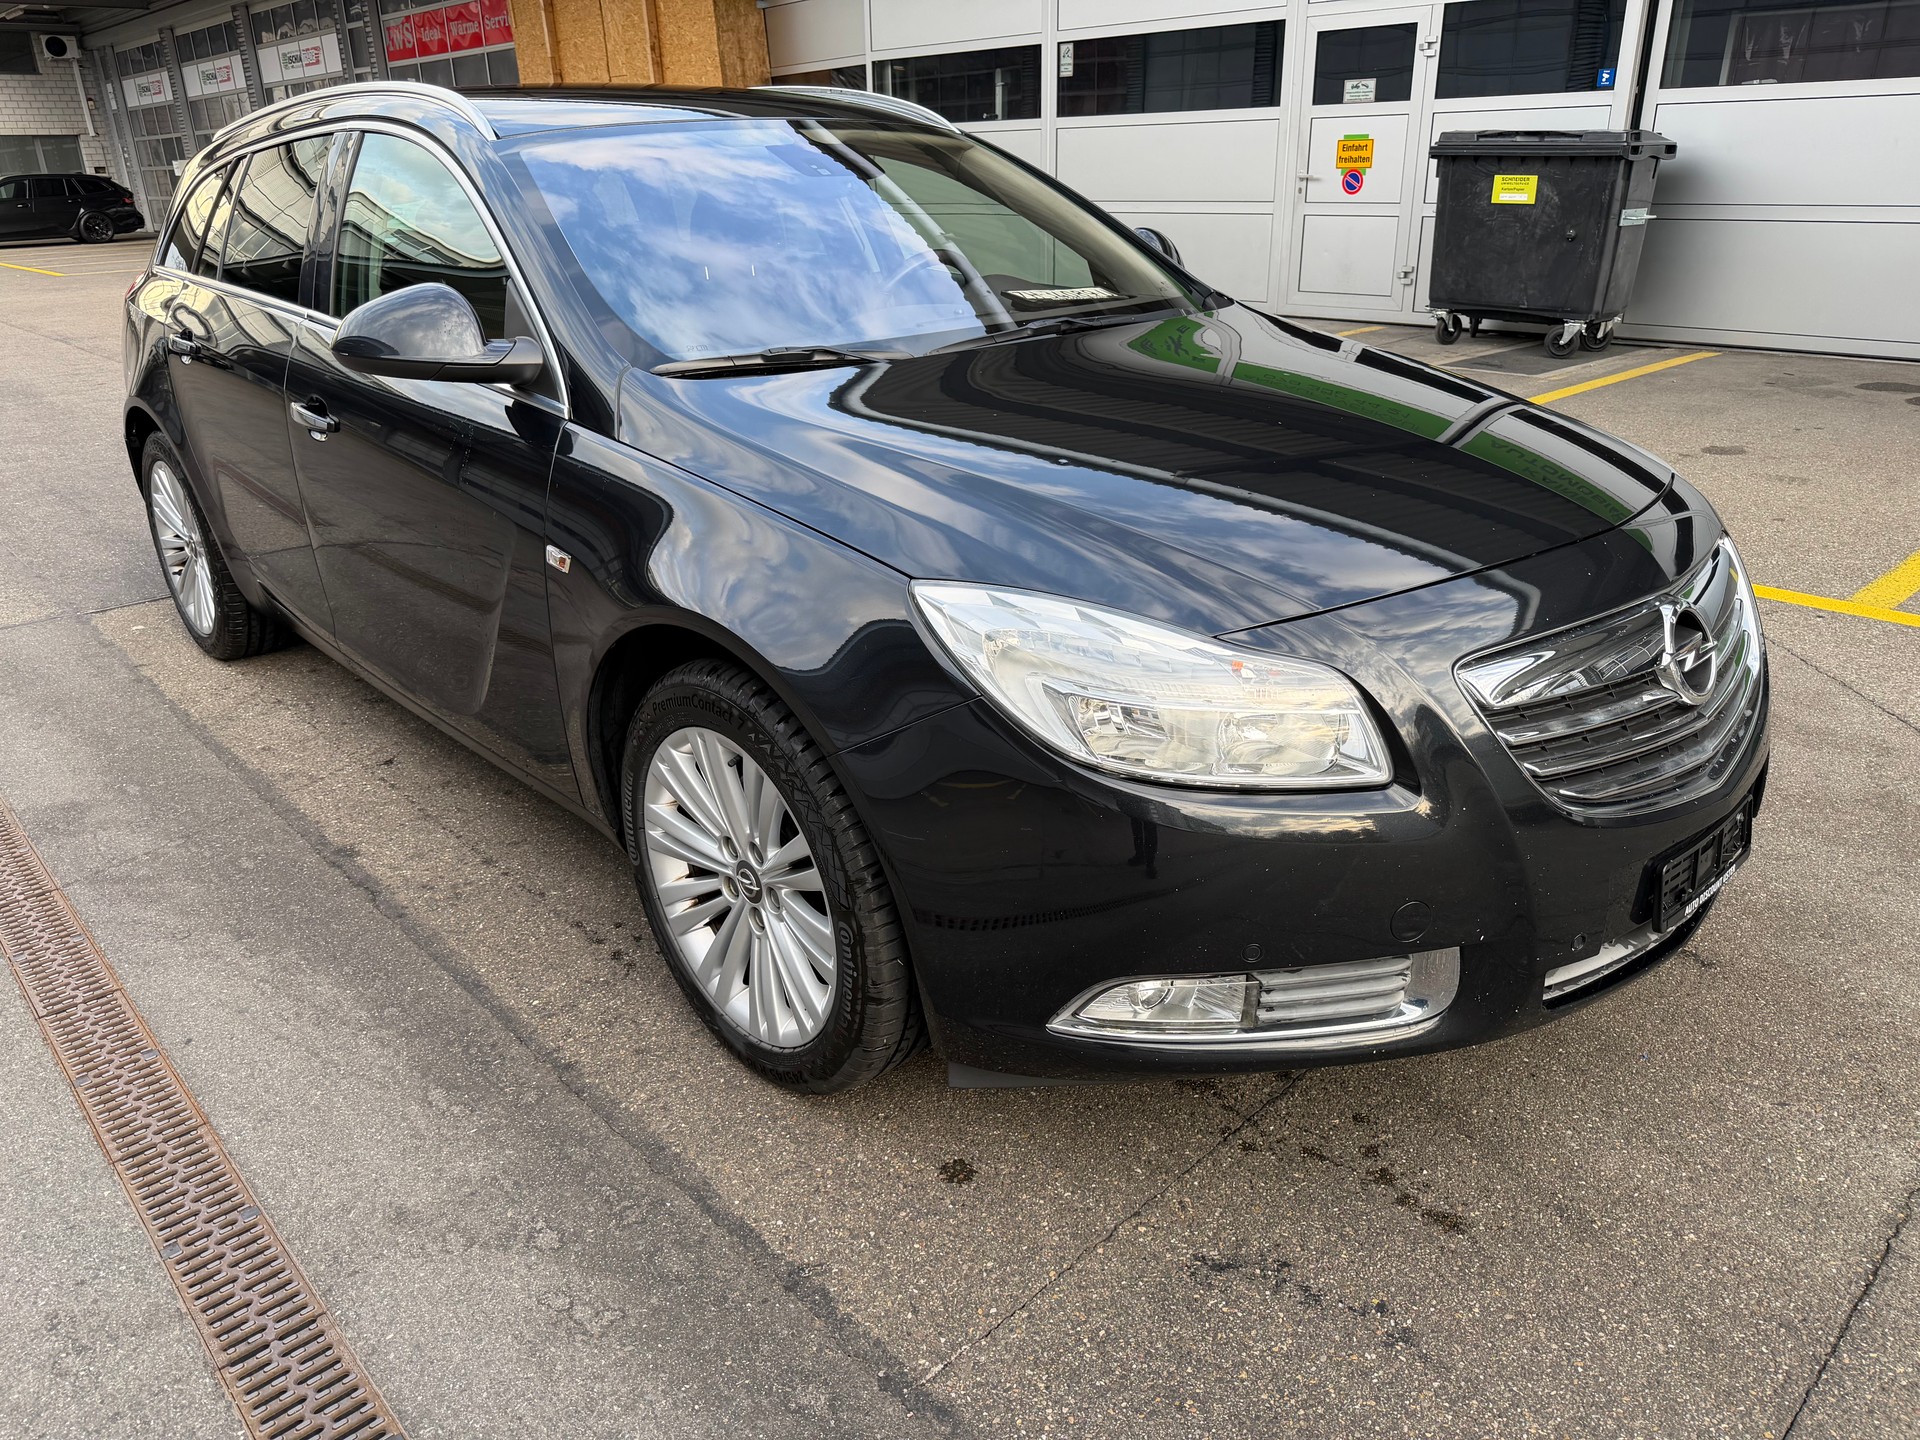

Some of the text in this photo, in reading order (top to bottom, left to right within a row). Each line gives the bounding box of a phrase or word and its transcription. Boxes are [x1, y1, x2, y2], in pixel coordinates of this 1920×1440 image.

[421, 25, 441, 42] Ideal
[449, 20, 480, 36] Wärme
[1342, 144, 1368, 152] Einfahrt
[1339, 155, 1370, 164] freihalten
[652, 692, 745, 731] PremiumContact 7
[1685, 897, 1700, 916] AUTO
[838, 921, 858, 1038] Continental
